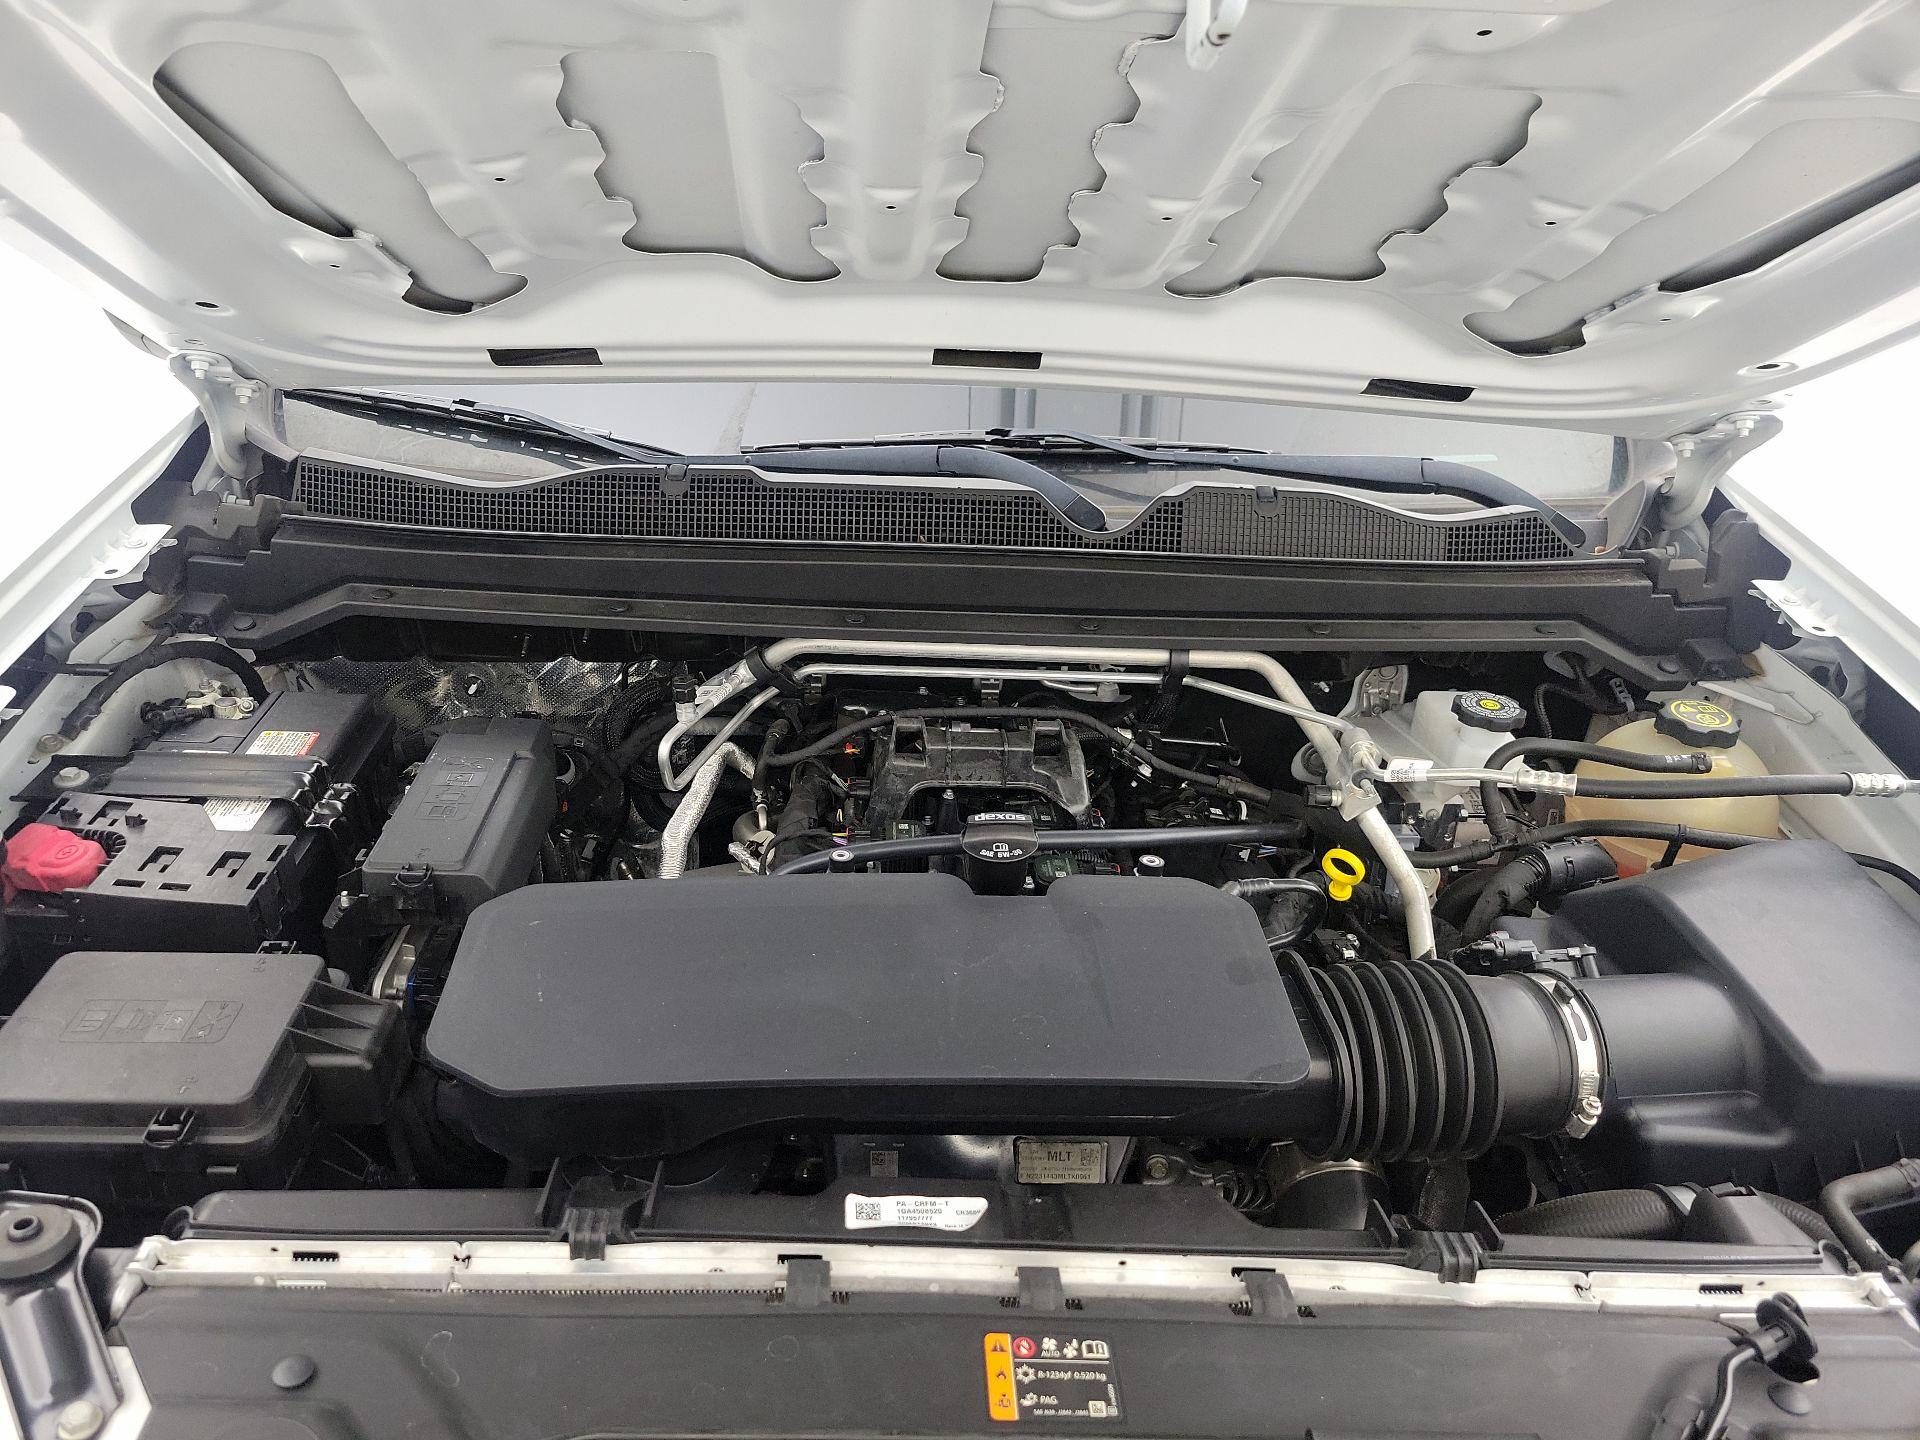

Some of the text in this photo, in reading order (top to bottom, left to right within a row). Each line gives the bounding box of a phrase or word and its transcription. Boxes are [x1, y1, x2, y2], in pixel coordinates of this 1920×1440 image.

[974, 813, 1025, 821] dexos
[980, 849, 994, 857] SAE
[1046, 1150, 1073, 1162] MLT
[1041, 1350, 1060, 1358] AUTO
[1039, 1395, 1059, 1406] PAG
